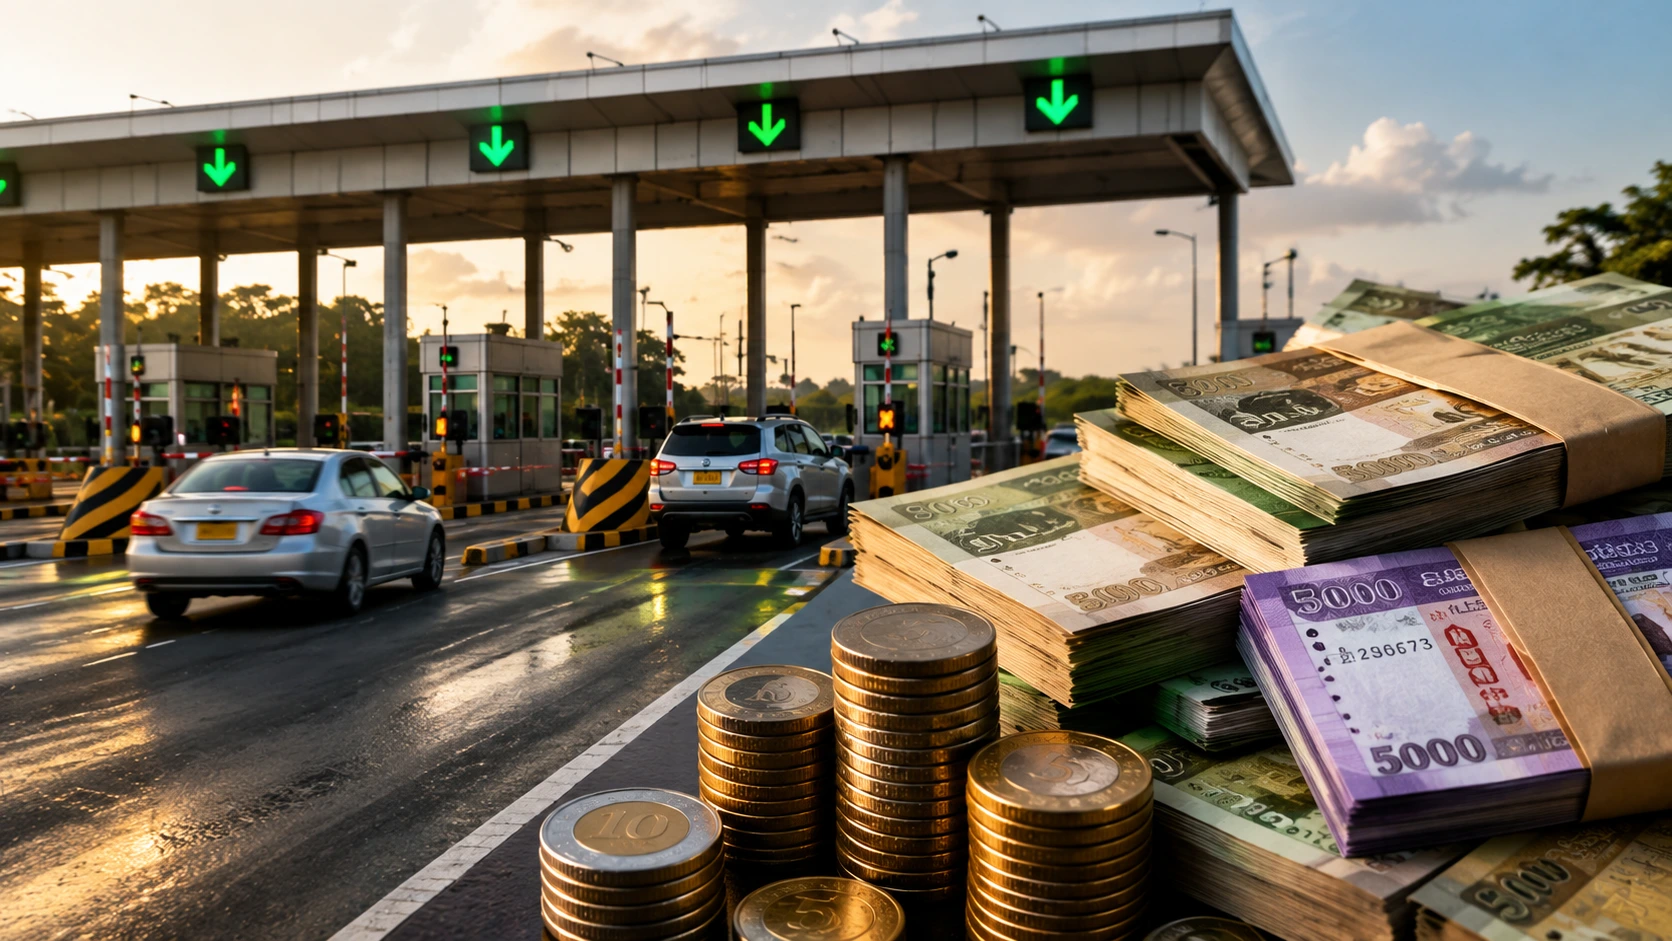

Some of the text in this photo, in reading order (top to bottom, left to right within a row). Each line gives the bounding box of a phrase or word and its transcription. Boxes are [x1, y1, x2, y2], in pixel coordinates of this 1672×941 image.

[1291, 578, 1403, 615] 5000
[1369, 733, 1487, 775] 5000
[588, 810, 669, 841] 10
